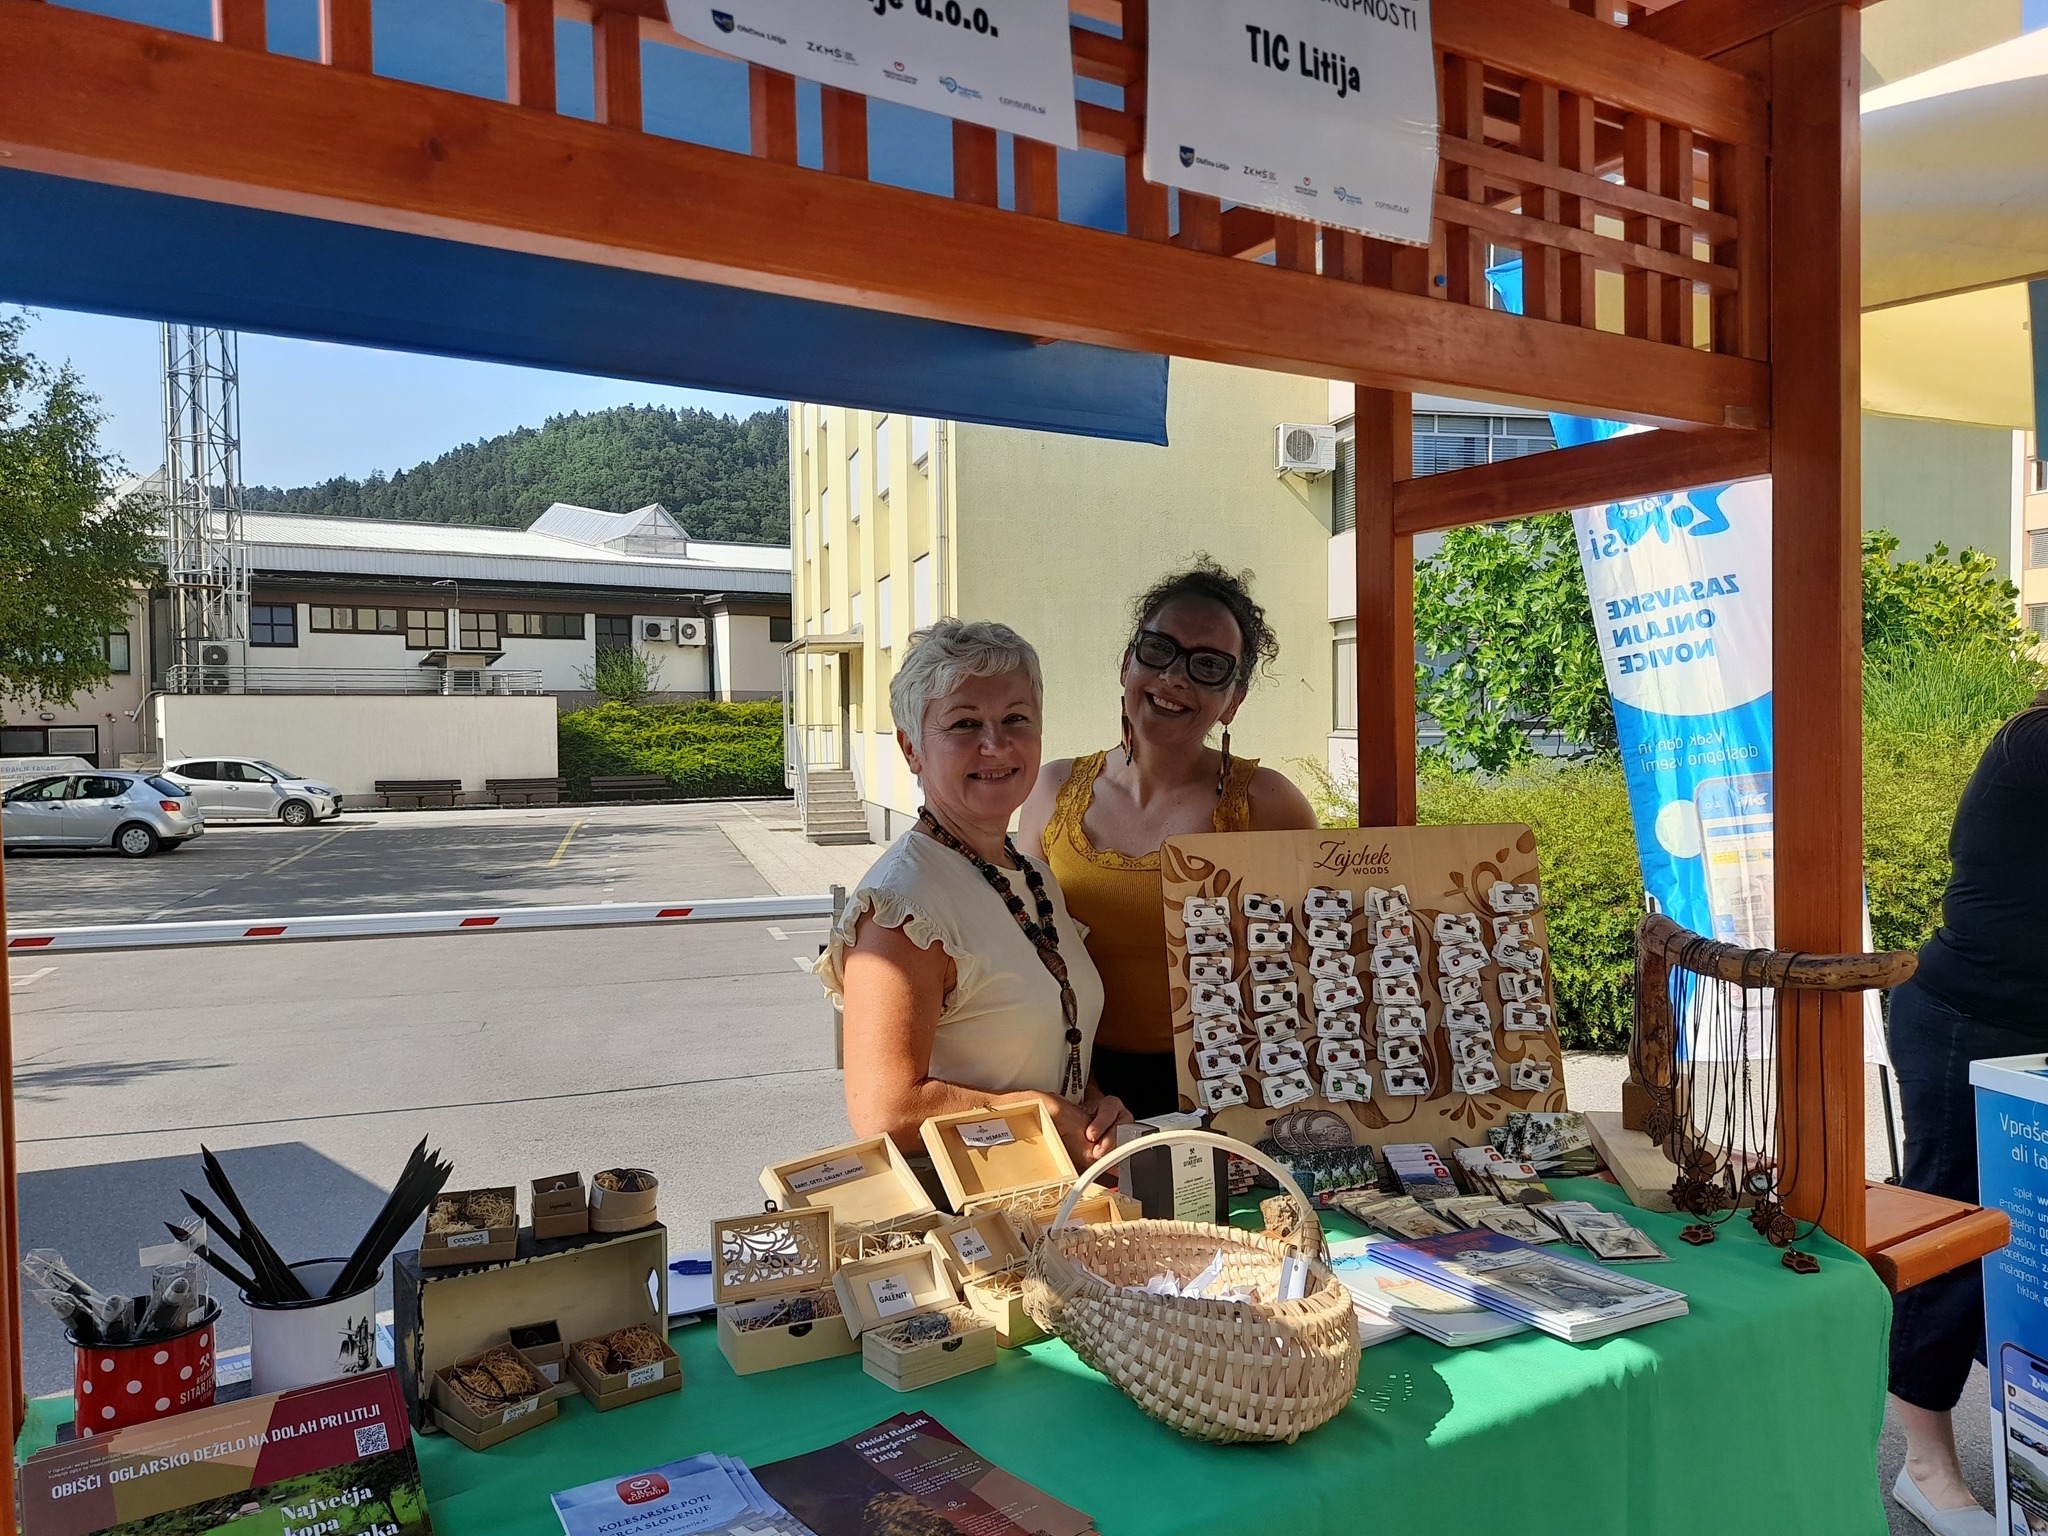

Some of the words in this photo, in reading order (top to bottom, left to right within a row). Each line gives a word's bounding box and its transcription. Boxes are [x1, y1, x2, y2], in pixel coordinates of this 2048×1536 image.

[1246, 24, 1290, 72] TIC
[1300, 40, 1360, 98] Litija
[1243, 165, 1268, 179] ZKMŠ
[1313, 841, 1392, 877] Zajchek
[1353, 867, 1389, 875] WOODS
[2011, 1144, 2028, 1164] ali
[878, 1291, 907, 1304] GALENIT
[855, 1432, 889, 1451] Obišči
[888, 1418, 929, 1440] Rudnik
[863, 1432, 919, 1457] Sitarjevec
[51, 1474, 102, 1500] OBIŠČI
[109, 1451, 190, 1485] OGLARSKO
[193, 1437, 246, 1463] DEŽELO
[249, 1432, 270, 1449] NA
[271, 1419, 318, 1443] DOLAH
[319, 1413, 343, 1430] PRI
[344, 1403, 381, 1424] LITIJI
[872, 1449, 904, 1464] Litija
[627, 1488, 666, 1503] SLOVENIJE
[630, 1485, 659, 1498] SRCE
[280, 1486, 374, 1523] Največja
[598, 1503, 680, 1533] KOLESARSKE
[681, 1494, 712, 1510] POTI
[645, 1504, 712, 1530] SLOVENIJE
